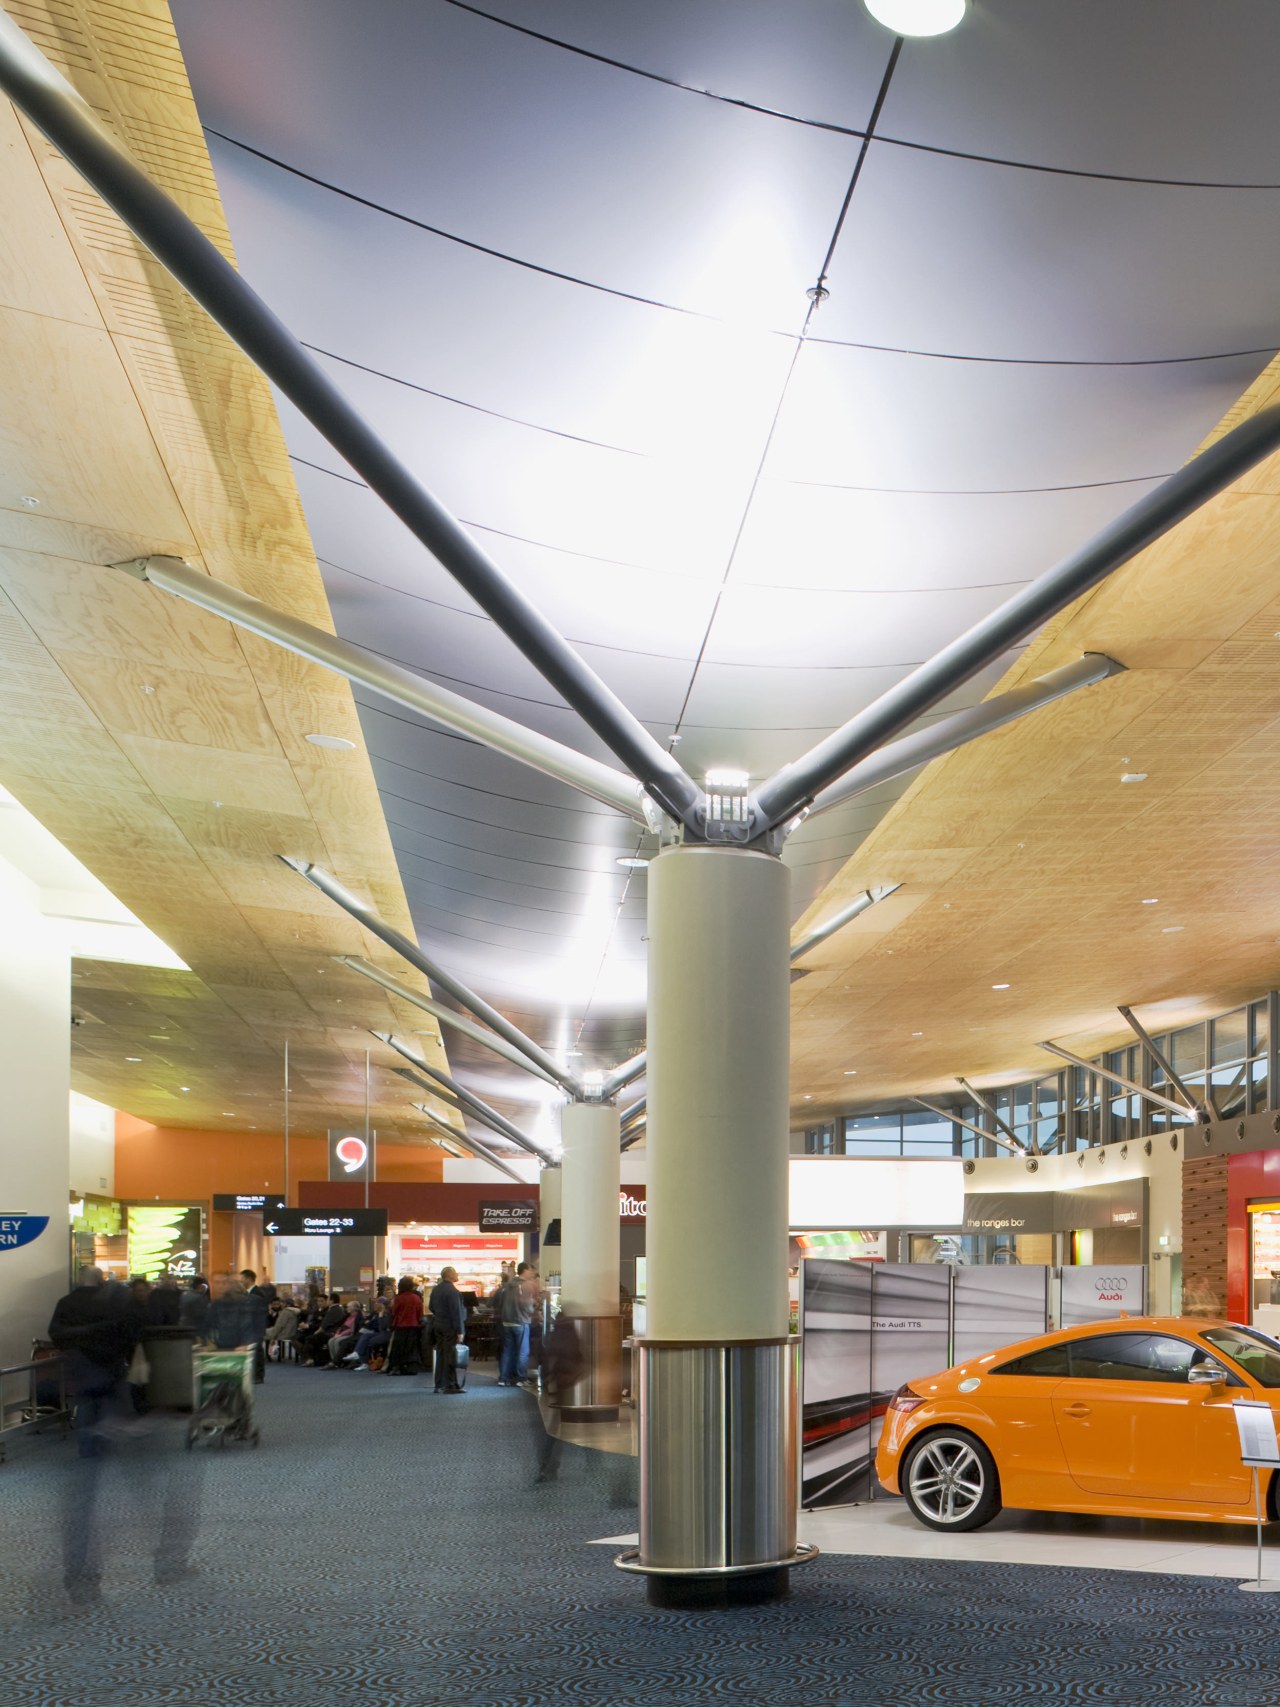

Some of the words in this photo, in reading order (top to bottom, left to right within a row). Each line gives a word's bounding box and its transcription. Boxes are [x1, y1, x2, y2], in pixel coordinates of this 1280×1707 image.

[483, 1208, 510, 1217] TAKE
[512, 1208, 534, 1217] OFF
[304, 1217, 328, 1226] Gates
[329, 1217, 353, 1226] 22-33
[482, 1217, 532, 1225] ESPRESSO
[967, 1218, 980, 1227] the
[981, 1220, 1009, 1229] ranges
[1011, 1218, 1025, 1227] bar
[1099, 1292, 1123, 1301] Audi
